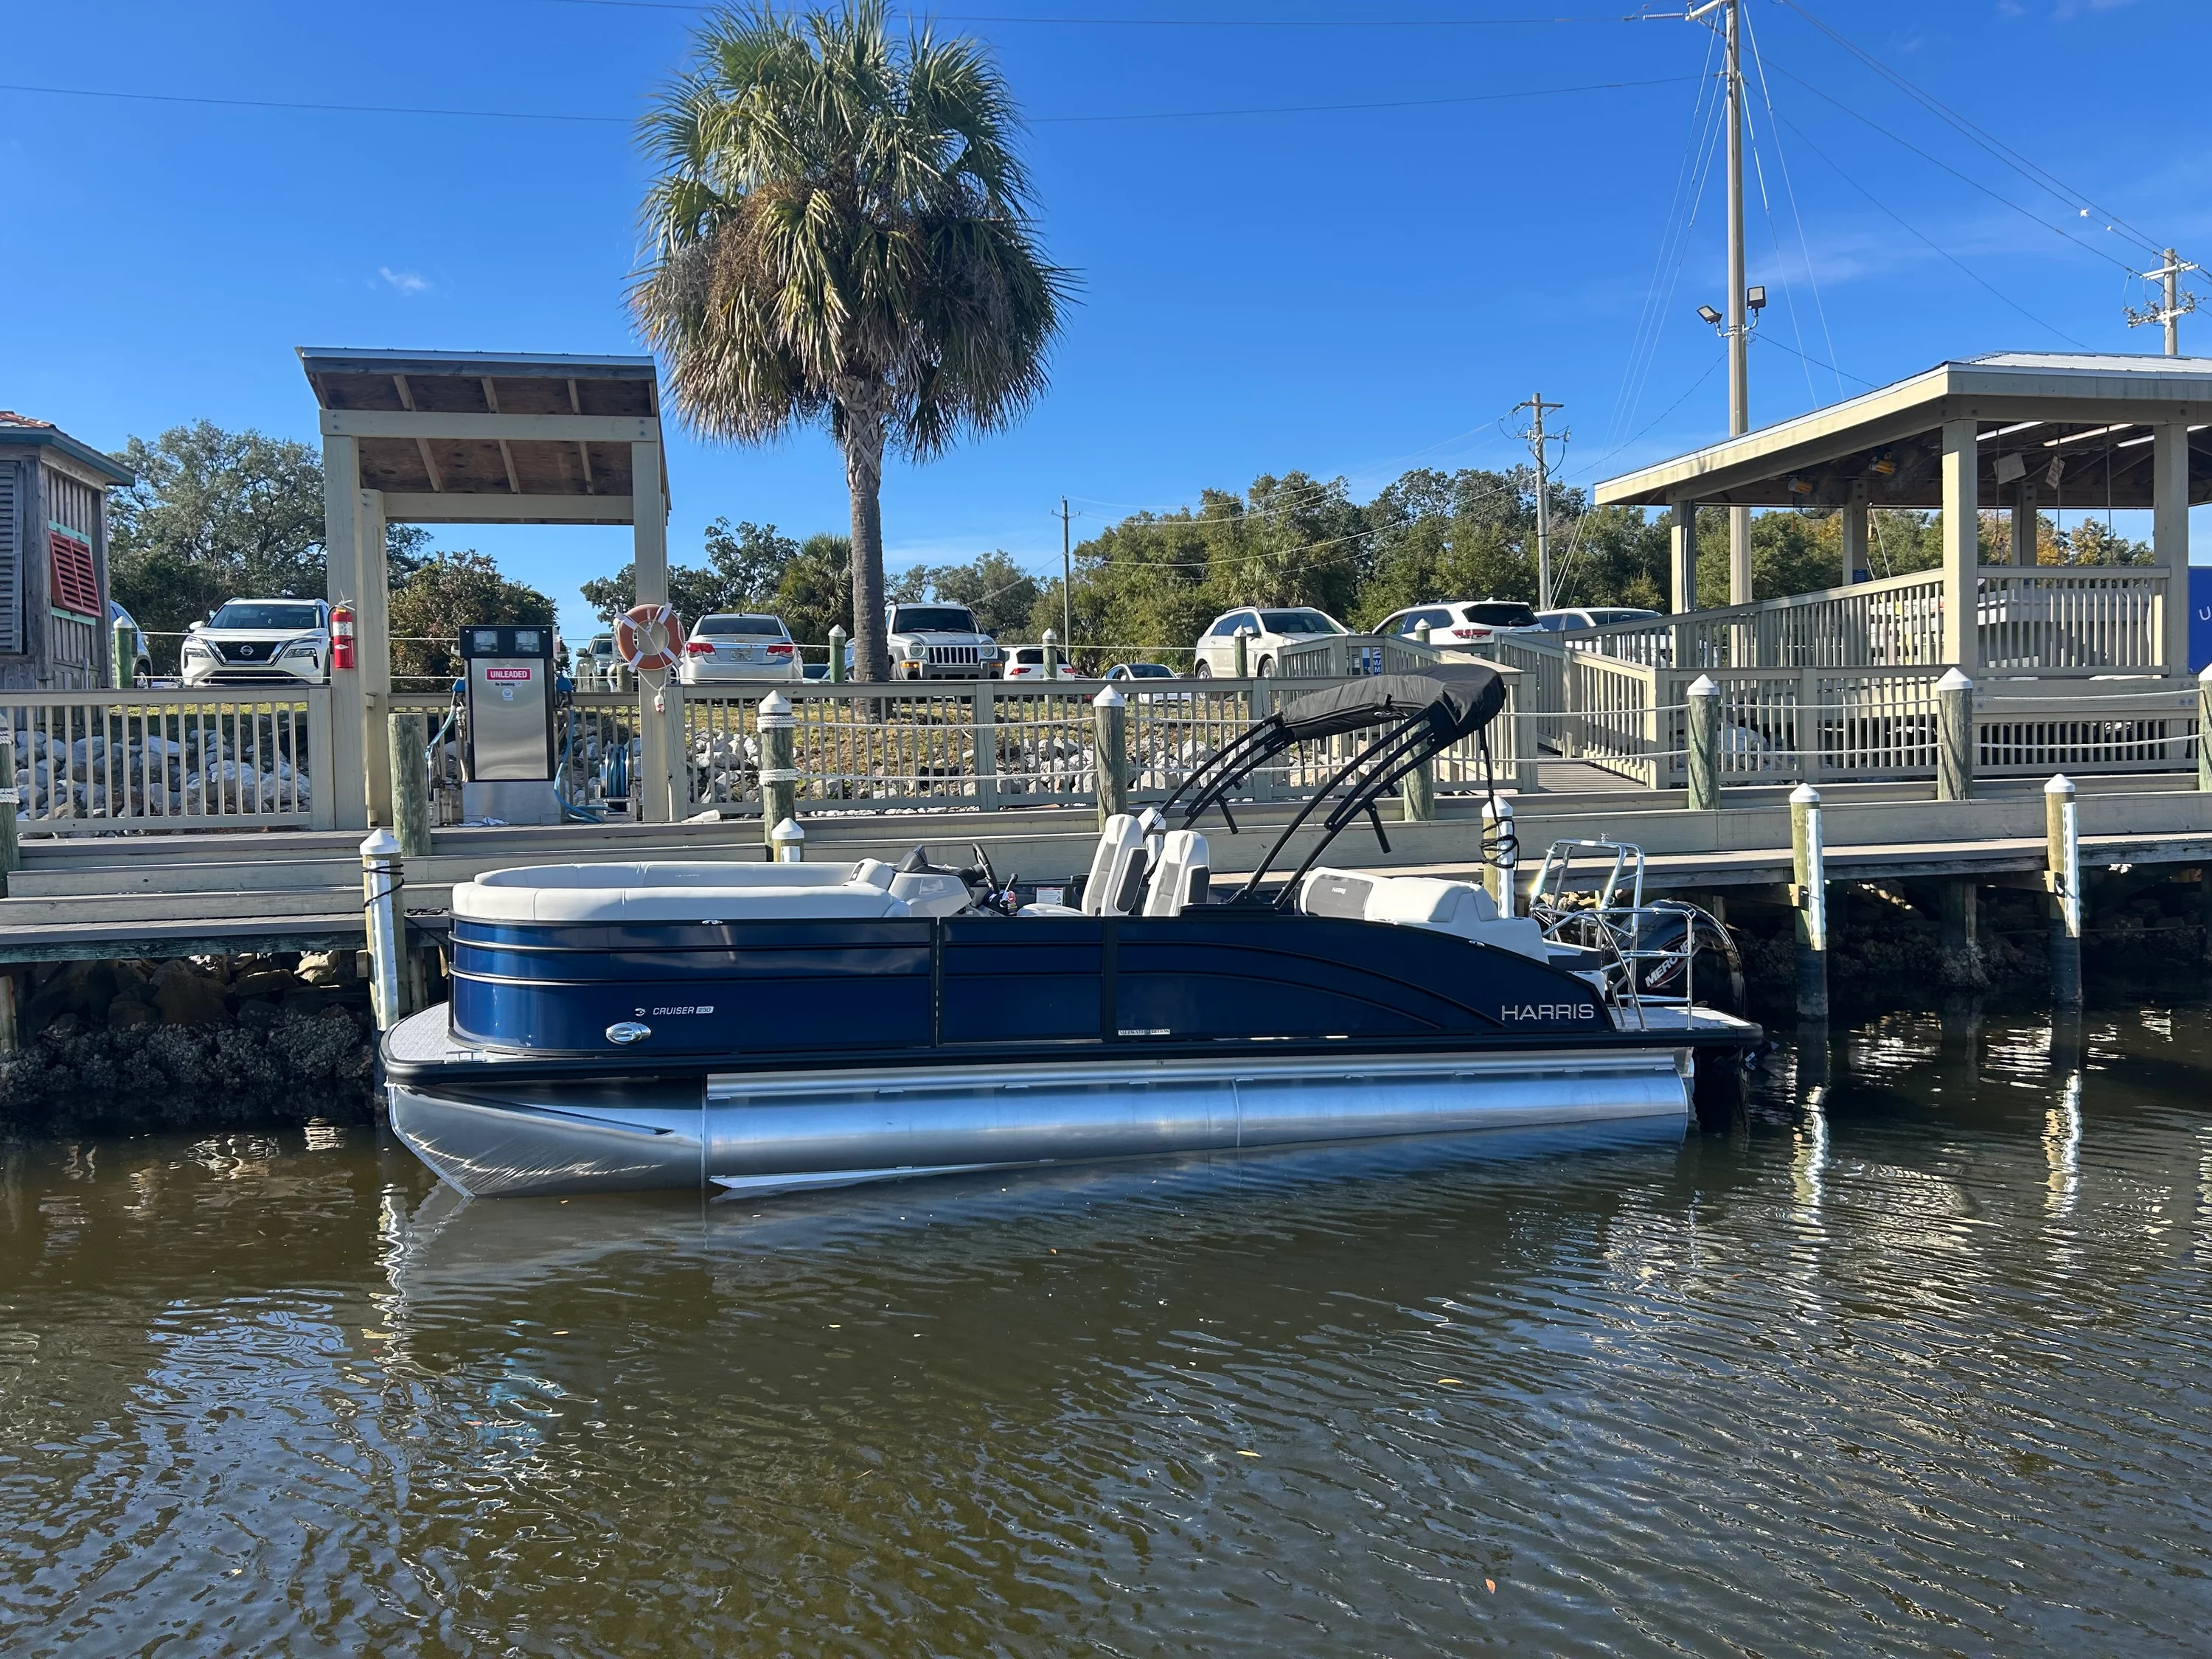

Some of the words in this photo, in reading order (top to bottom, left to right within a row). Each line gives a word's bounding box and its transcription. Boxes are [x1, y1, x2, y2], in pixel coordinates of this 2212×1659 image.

[490, 670, 528, 678] UNLEADED
[653, 1006, 695, 1015] CRUISER
[1501, 1004, 1594, 1020] HARRIS
